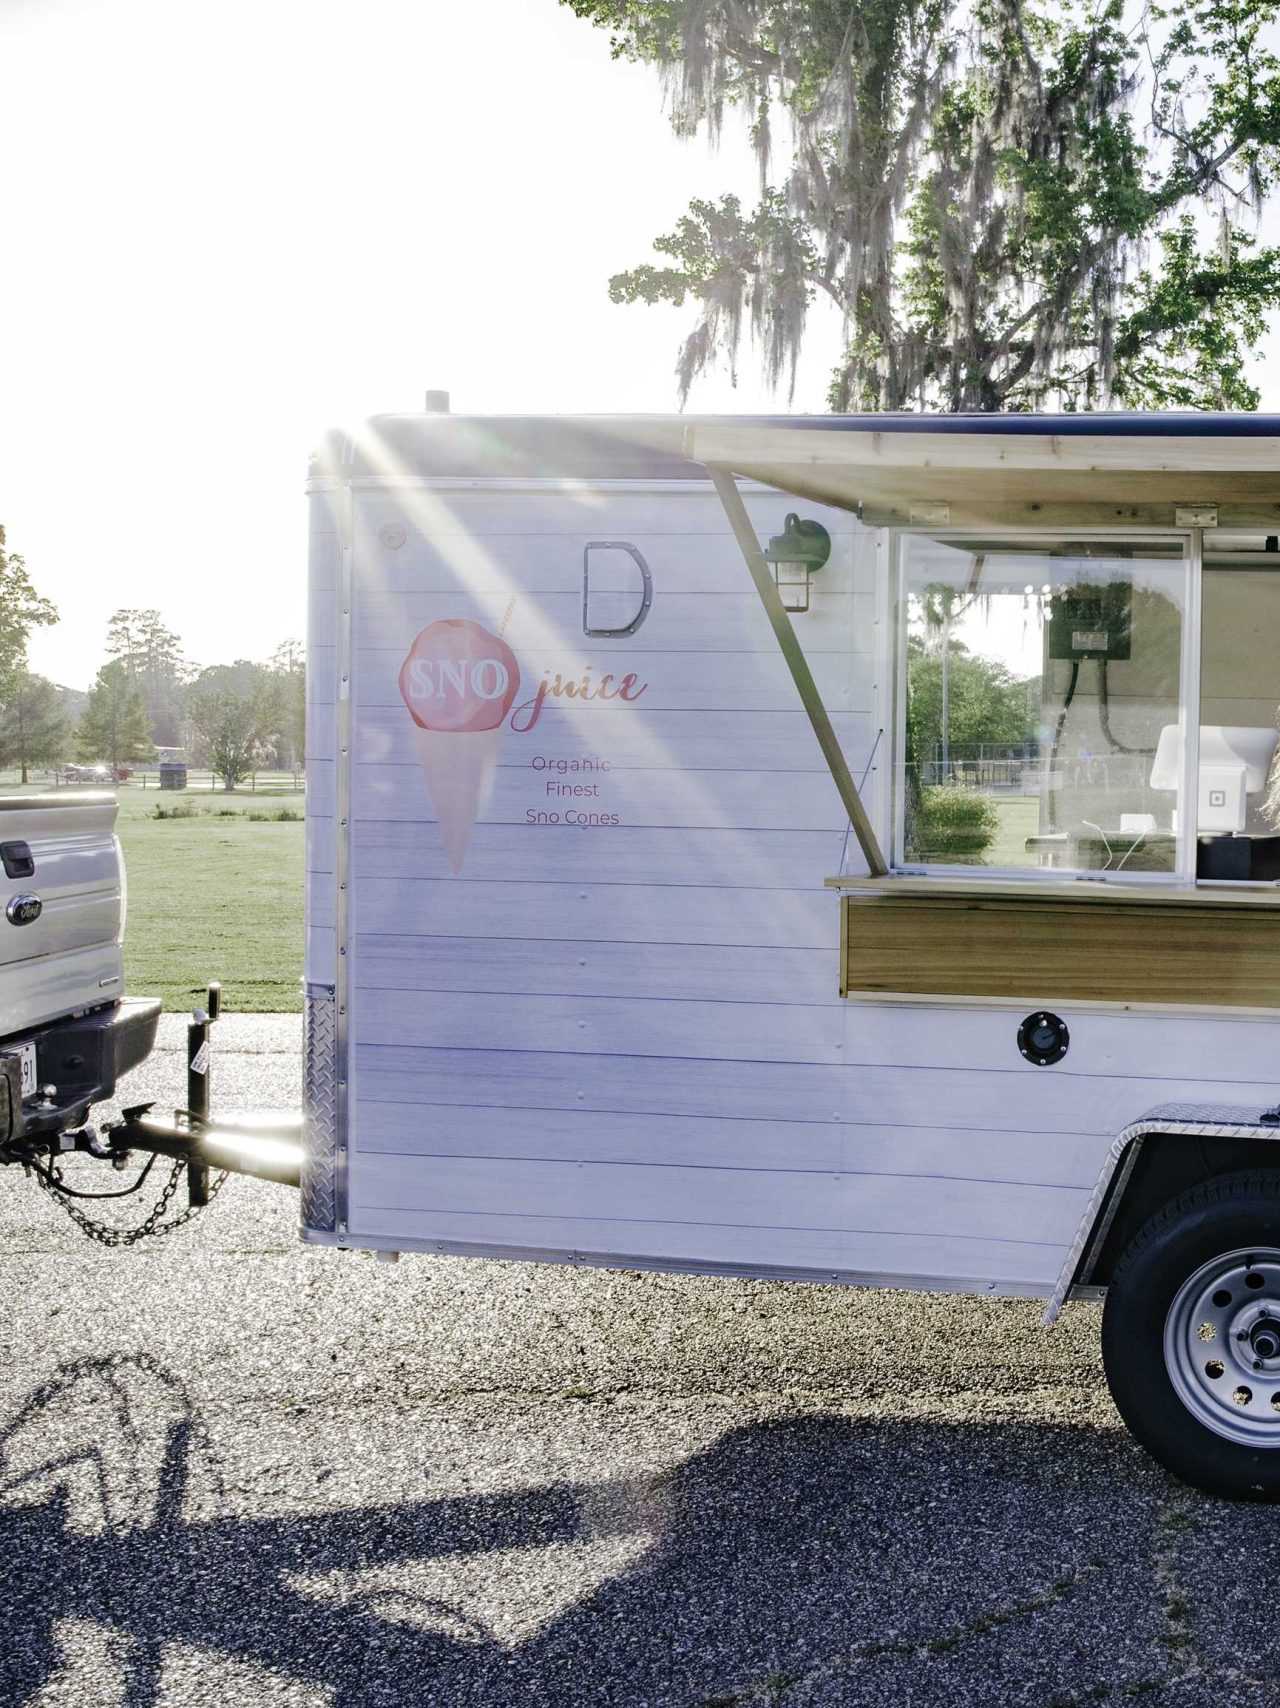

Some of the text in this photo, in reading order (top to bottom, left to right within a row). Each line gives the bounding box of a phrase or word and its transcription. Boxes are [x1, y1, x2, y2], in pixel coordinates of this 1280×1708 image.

[407, 657, 510, 701] SNO
[511, 666, 648, 732] juice
[531, 756, 611, 774] Organic
[546, 780, 600, 797] Finest
[526, 808, 620, 826] Sno Cones
